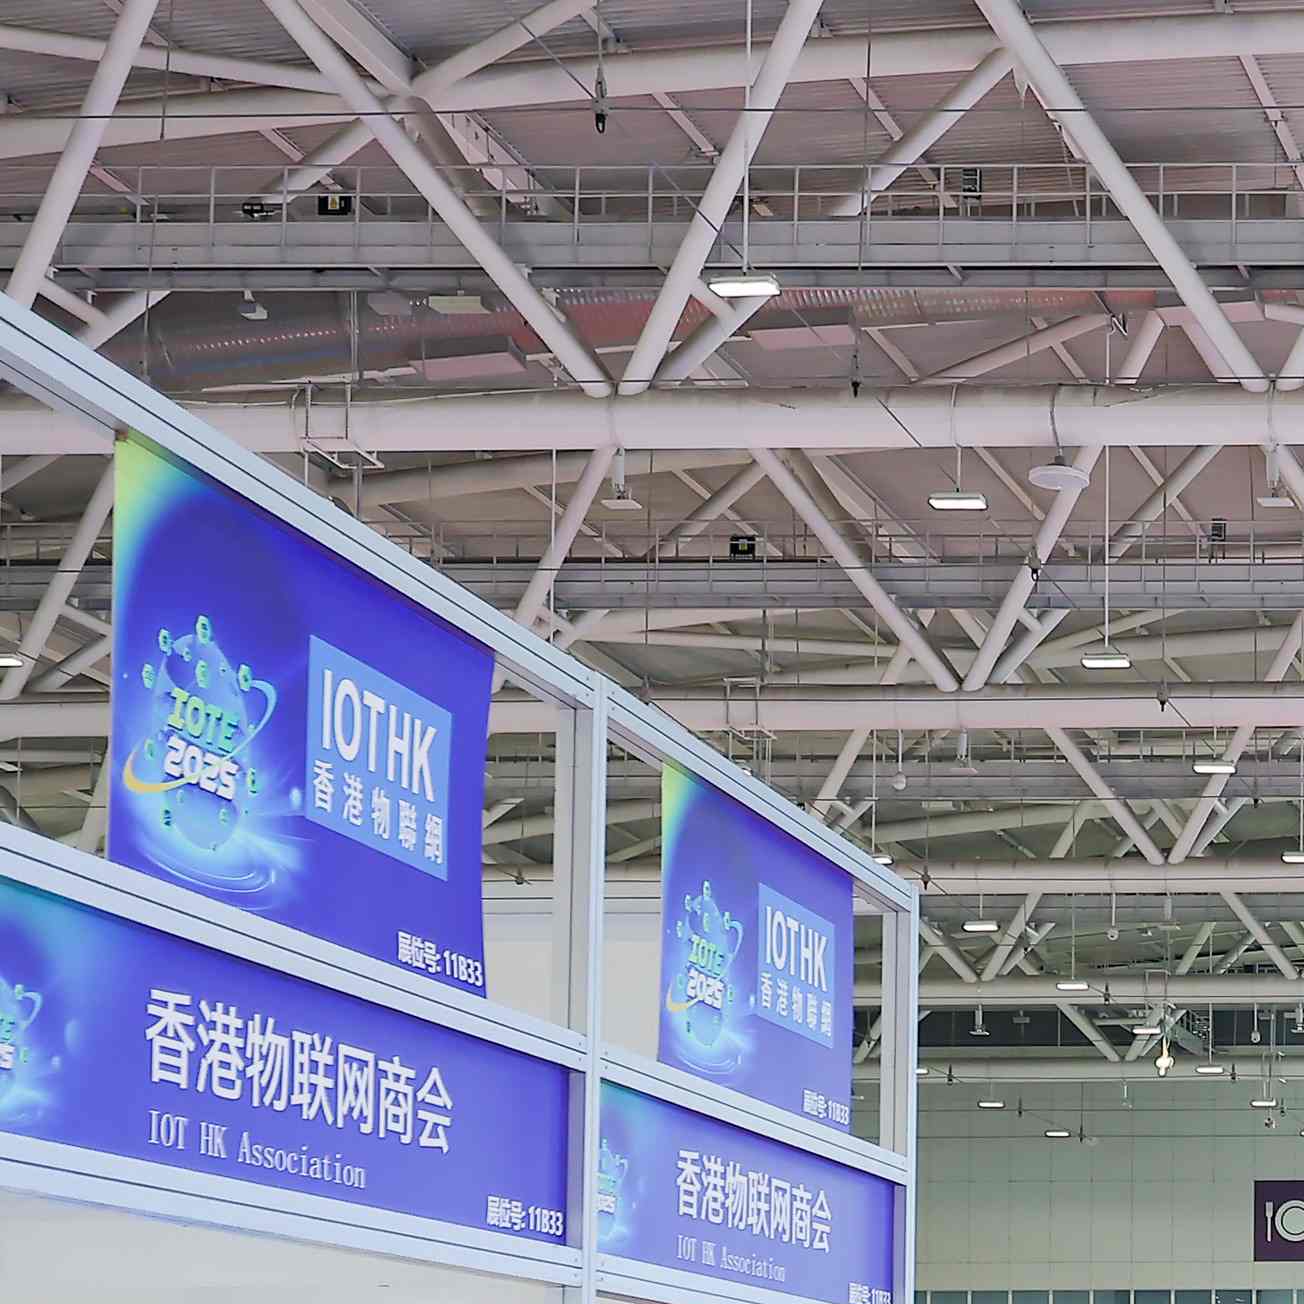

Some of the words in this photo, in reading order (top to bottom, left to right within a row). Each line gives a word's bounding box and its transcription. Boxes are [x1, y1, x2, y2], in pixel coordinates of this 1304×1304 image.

[167, 687, 239, 753] IOTE
[321, 669, 438, 802] IOTHK
[164, 737, 240, 800] 2025
[443, 951, 484, 987] 11B33
[766, 906, 828, 992] IOTHK
[687, 966, 725, 1011] 2025
[145, 988, 455, 1154] 香港物联网商会
[148, 1110, 188, 1150] IOT
[200, 1122, 228, 1160] HK
[238, 1131, 367, 1190] Association
[528, 1205, 565, 1238] 11B33
[676, 1149, 833, 1254] 香港物联网商会
[676, 1234, 697, 1262] IOT
[720, 1246, 786, 1283] Association
